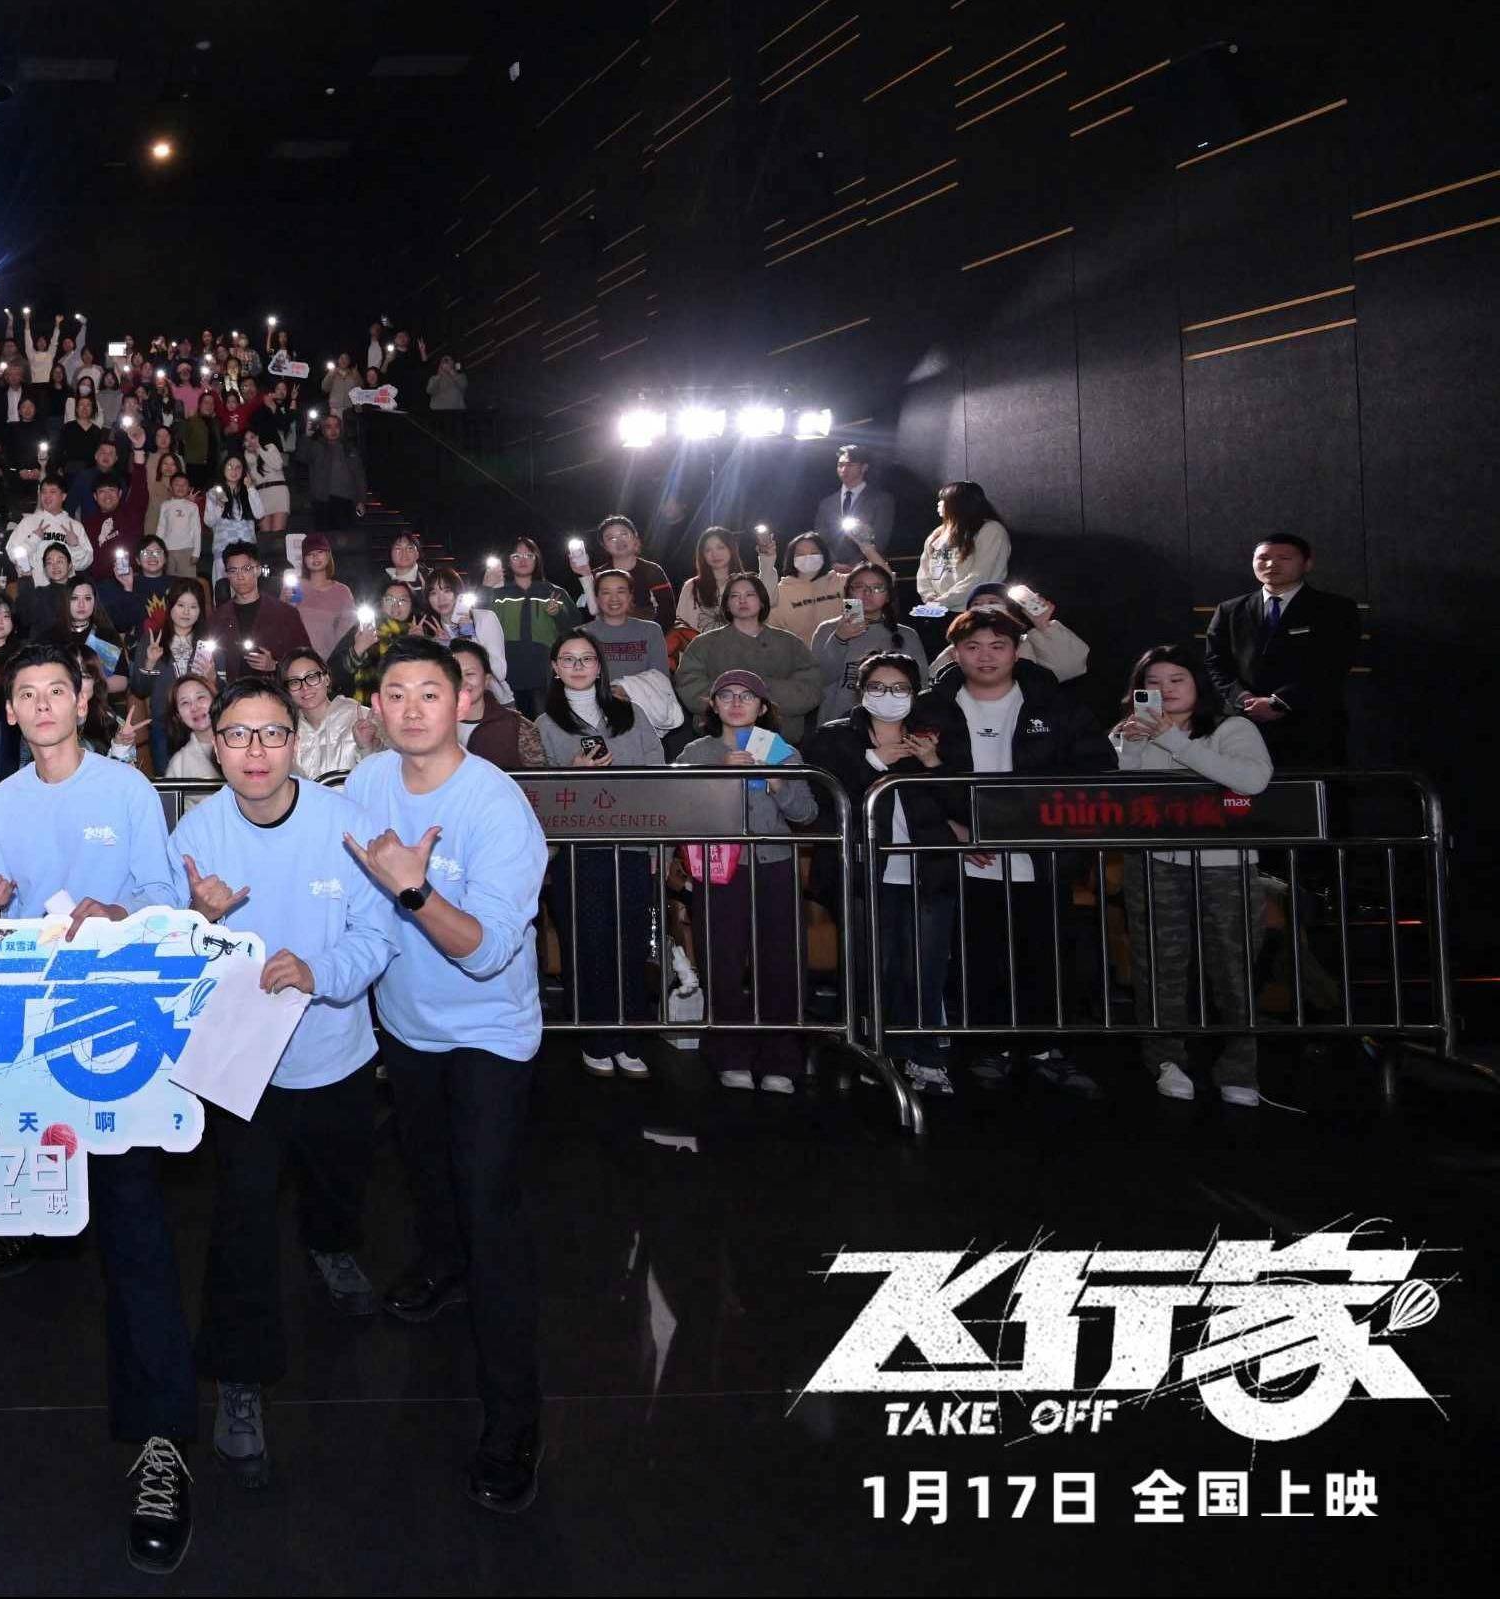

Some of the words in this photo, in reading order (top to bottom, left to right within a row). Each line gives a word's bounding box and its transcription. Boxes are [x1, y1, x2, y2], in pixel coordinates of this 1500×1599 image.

[1223, 797, 1251, 807] max
[543, 814, 605, 828] VERSEAS
[610, 813, 668, 827] CENTER
[5, 940, 37, 952] 双雪涛
